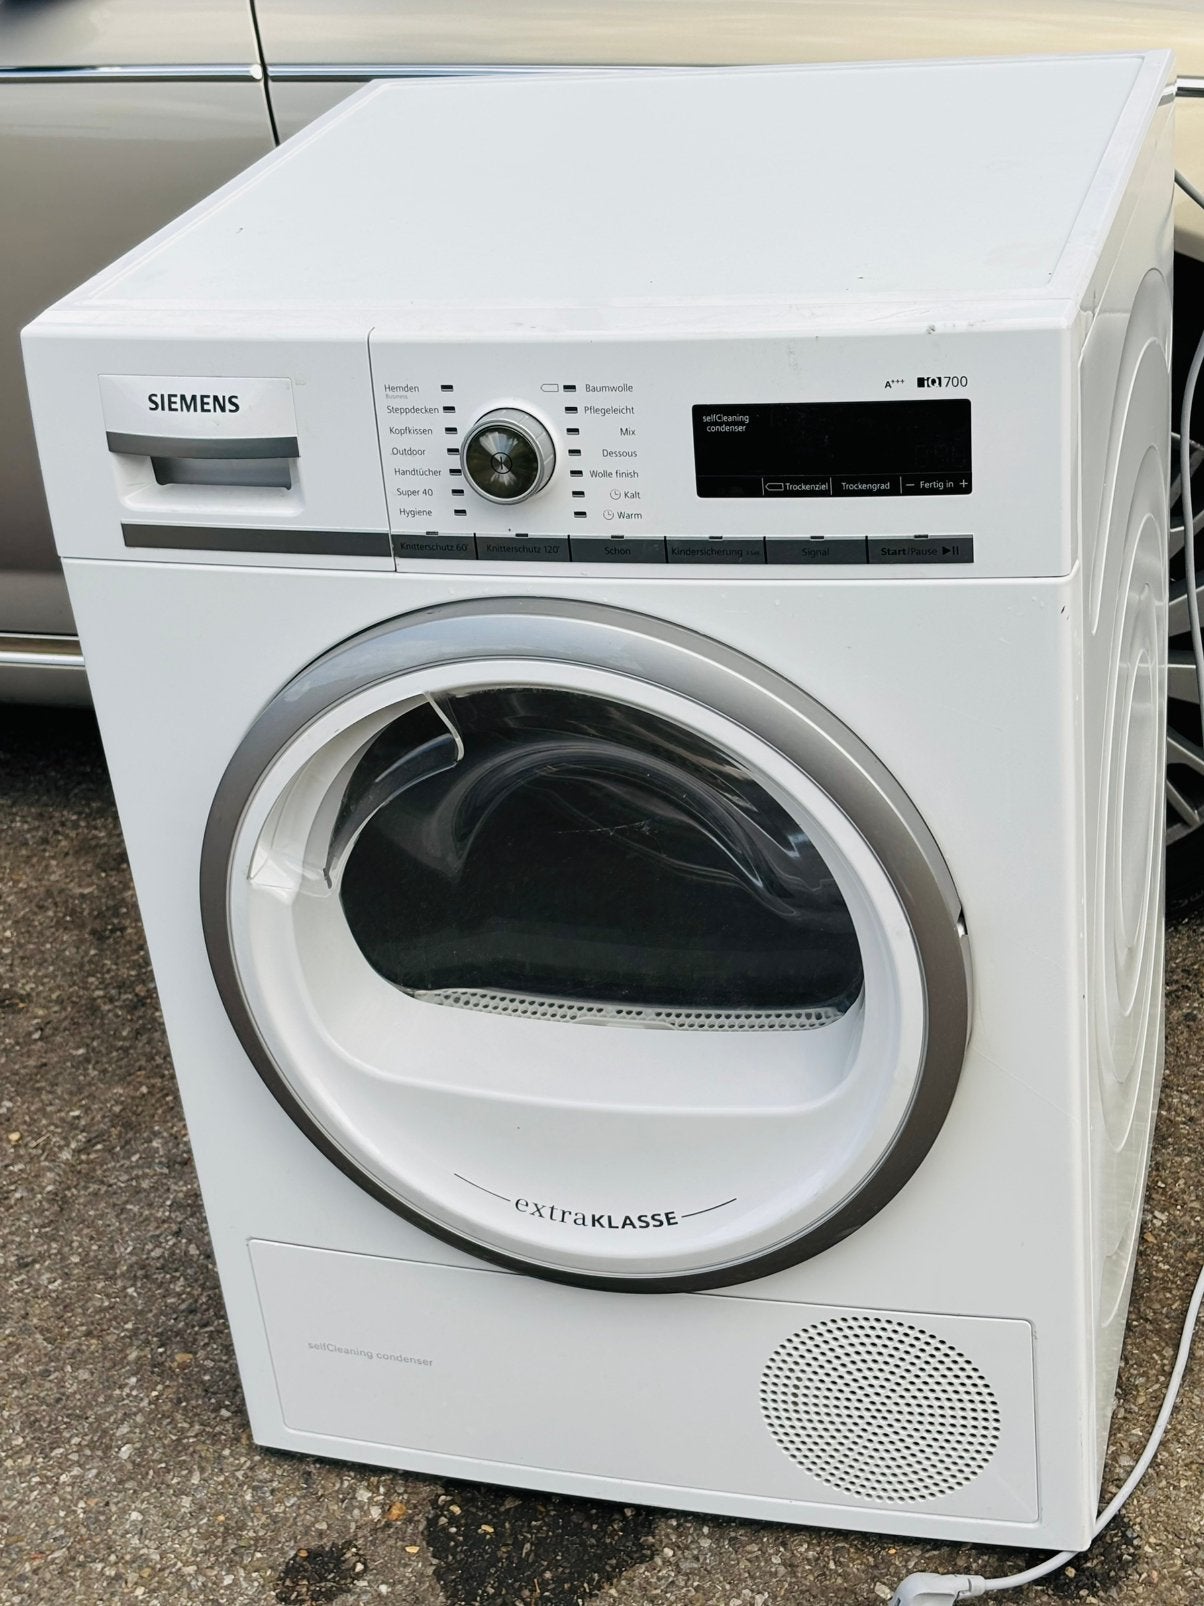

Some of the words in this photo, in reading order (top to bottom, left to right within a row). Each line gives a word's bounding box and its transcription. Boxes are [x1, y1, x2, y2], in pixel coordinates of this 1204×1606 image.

[384, 383, 420, 393] Hemden
[585, 383, 633, 393] Baumwolle
[148, 393, 240, 413] SIEMENS
[387, 405, 439, 416] Steppdecken
[584, 405, 635, 416] Pflegeleicht
[702, 413, 750, 424] selfCleaning
[389, 426, 433, 437] Kopfkissen
[619, 427, 636, 437] Mix
[706, 424, 747, 433] condenser
[391, 447, 426, 456] Outdoor
[602, 448, 638, 458] Dessous
[394, 467, 442, 477] Handtücher
[589, 469, 614, 479] Wolle
[615, 469, 639, 479] finish
[785, 482, 828, 492] Trockenziel
[842, 481, 890, 492] Trockengrad
[919, 480, 945, 490] Fertig
[946, 480, 954, 489] in
[397, 488, 420, 498] Super
[421, 487, 434, 497] 40
[624, 490, 641, 500] Kalt
[399, 507, 433, 518] Hygiene
[617, 511, 643, 520] Warm
[400, 541, 454, 552] Knitterschutz
[486, 543, 541, 554] Knitterschutz
[604, 546, 631, 556] Schon
[671, 546, 743, 559] Kindersicherung
[801, 547, 830, 558] Signal
[514, 1197, 679, 1230] extraKLASSE
[307, 1341, 375, 1360] selfCleaning
[376, 1351, 434, 1367] condenser
